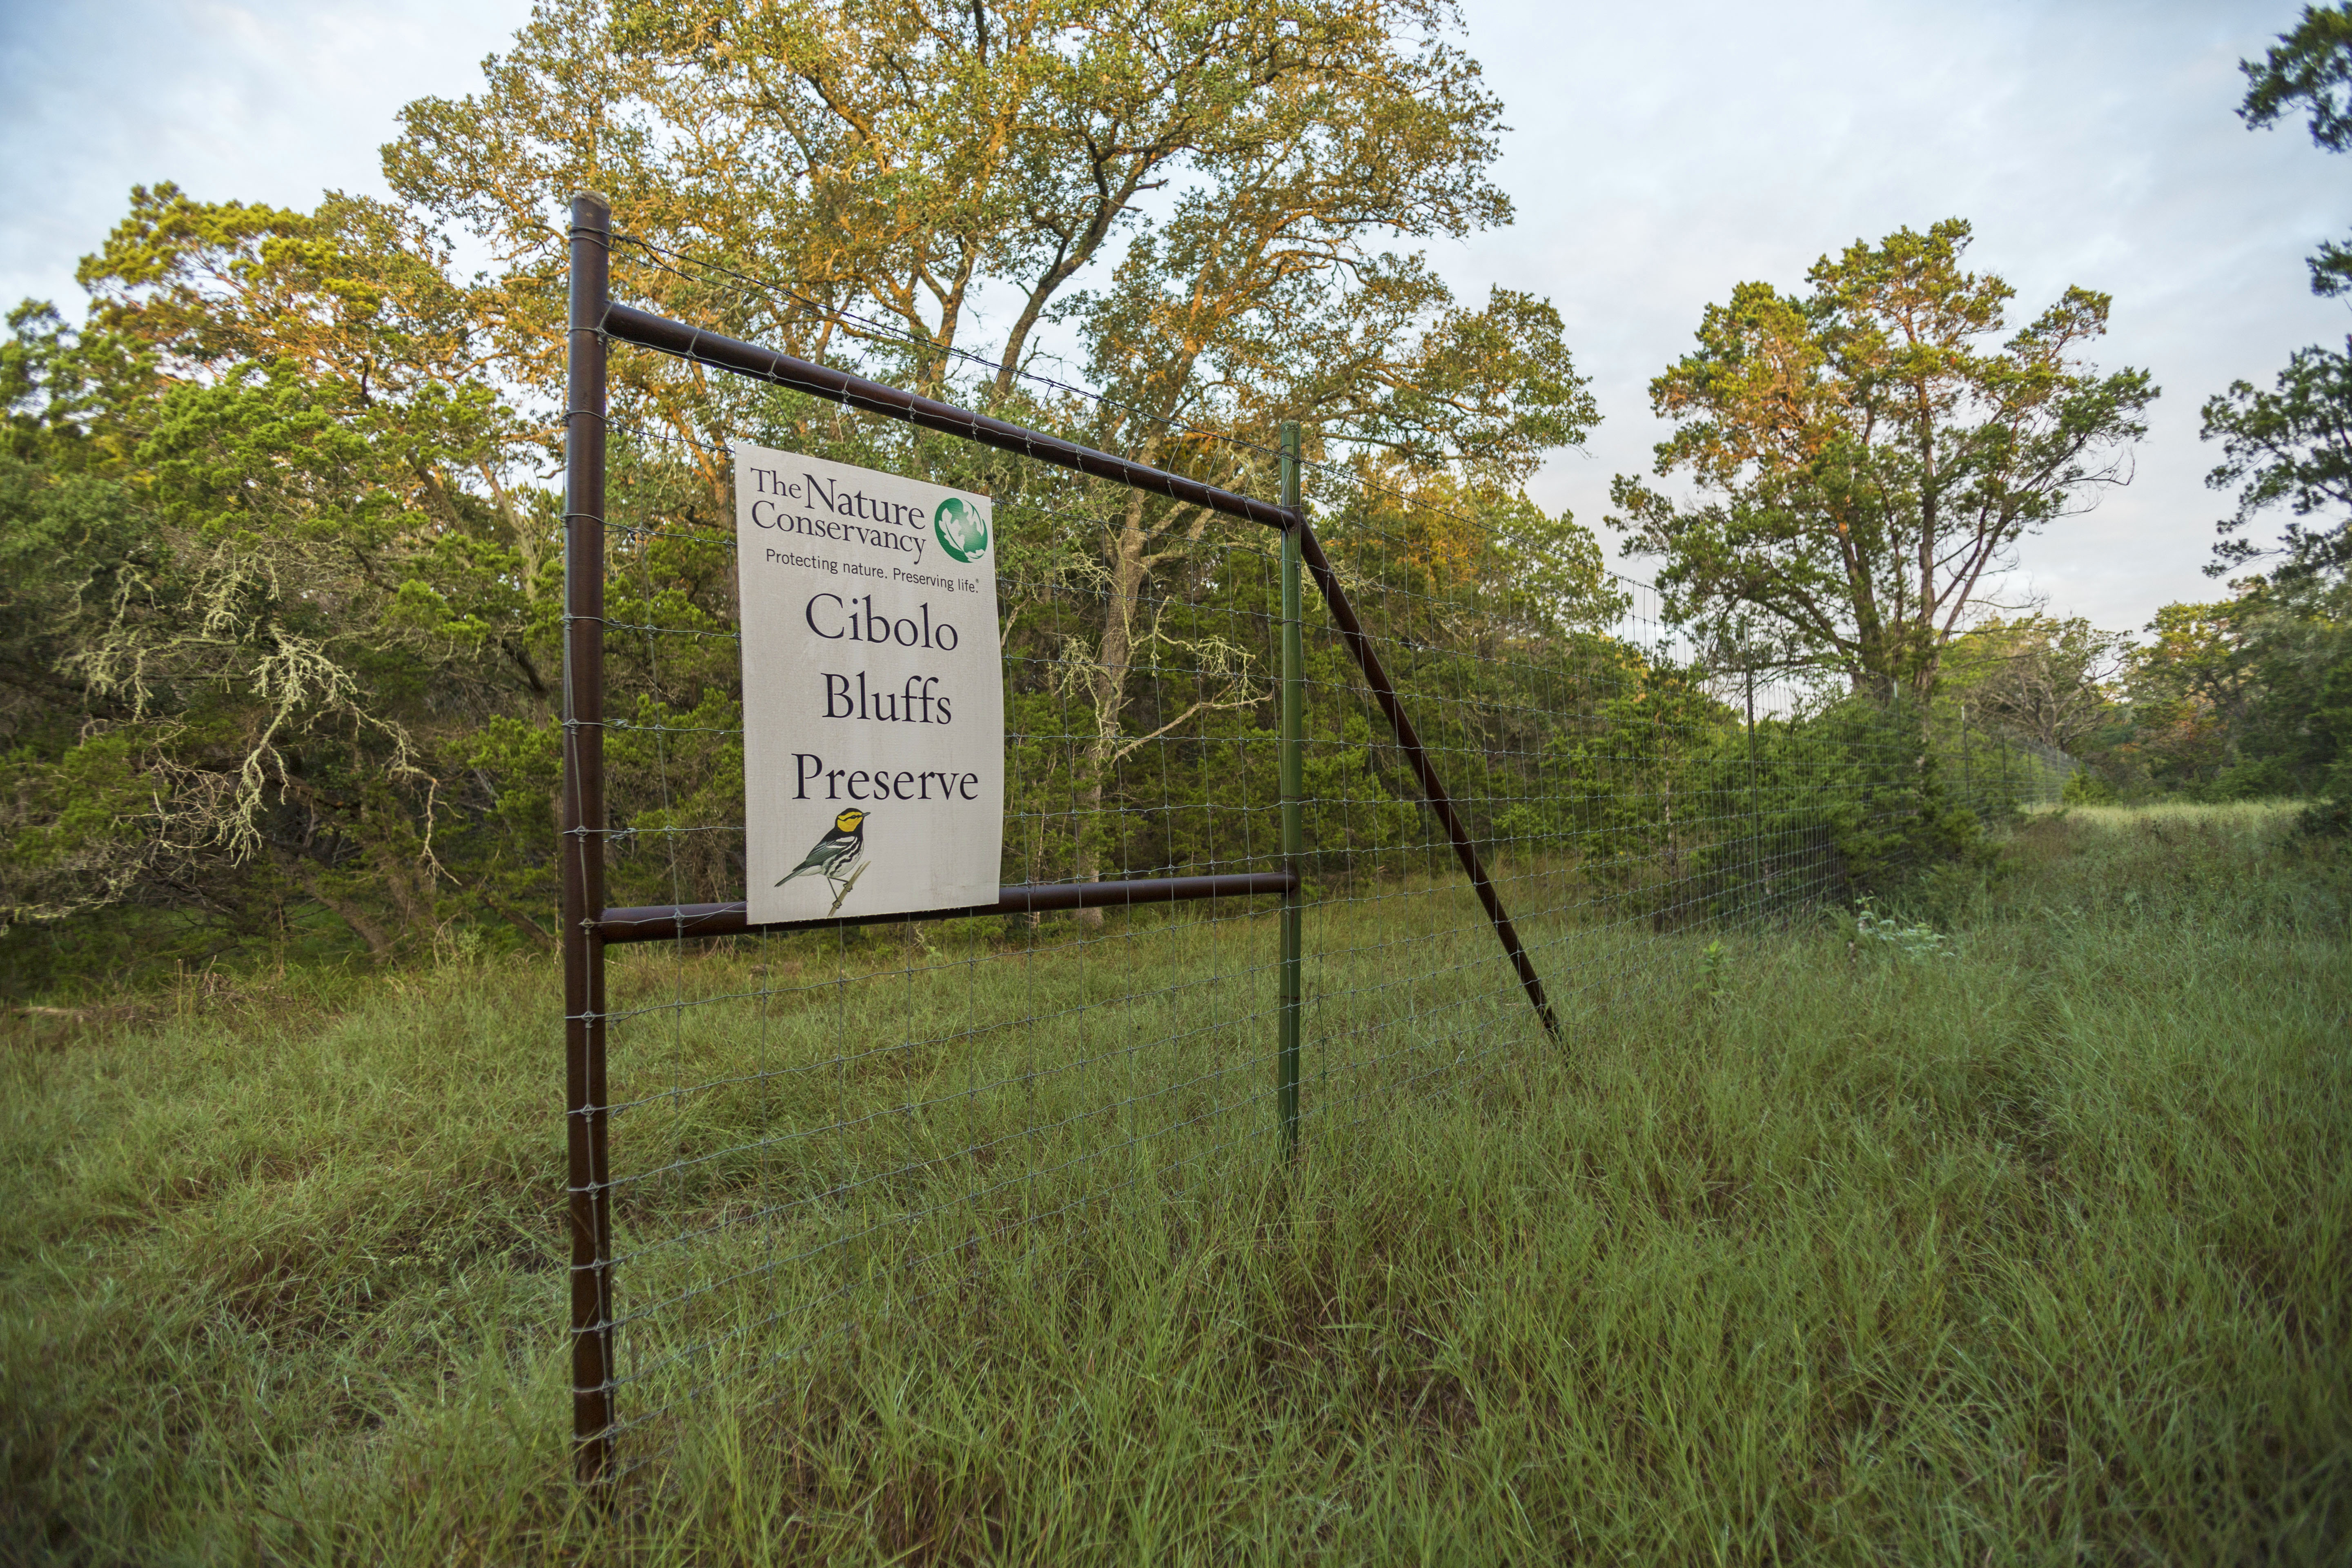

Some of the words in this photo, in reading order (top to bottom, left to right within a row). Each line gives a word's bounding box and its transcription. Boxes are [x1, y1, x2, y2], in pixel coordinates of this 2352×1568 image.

[751, 467, 801, 499] The
[803, 473, 926, 530] Nature
[751, 500, 927, 564] Conservancy
[766, 548, 837, 574] Protecting
[843, 562, 888, 579] nature.
[893, 568, 954, 592] Preserving
[806, 593, 958, 650] Cibolo
[821, 670, 951, 724] Bluffs
[791, 753, 979, 800] Preserve
